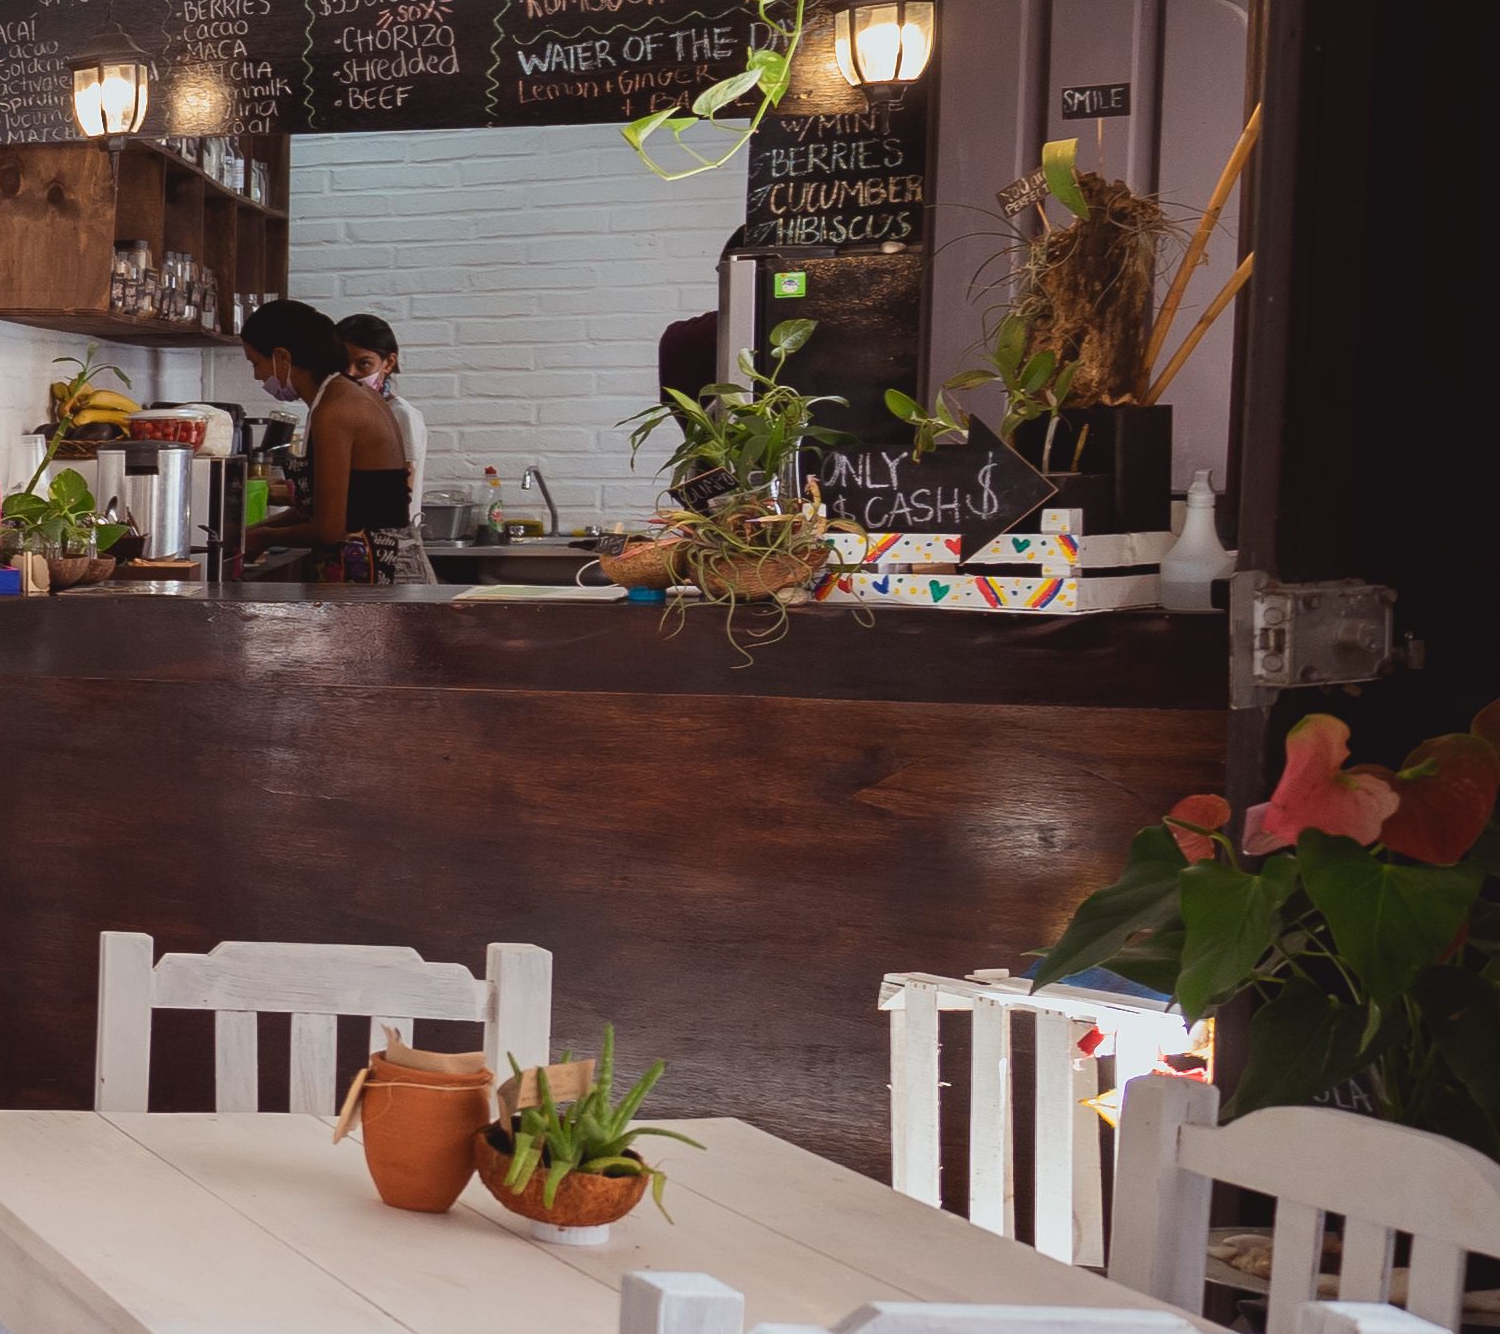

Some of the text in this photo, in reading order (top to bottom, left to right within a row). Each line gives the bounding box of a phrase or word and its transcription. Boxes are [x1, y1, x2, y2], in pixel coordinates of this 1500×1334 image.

[343, 24, 455, 53] CHORIZO
[518, 39, 616, 75] WATER
[622, 32, 664, 61] OF
[670, 27, 738, 62] THE
[349, 84, 414, 110] BEEF
[1063, 88, 1125, 114] SMILE
[7, 127, 78, 145] MATCH
[771, 138, 903, 178] BERRIES
[769, 174, 924, 215] CUCUMBER
[776, 211, 912, 245] HIBISCUS
[820, 450, 908, 491] ONLY
[865, 487, 960, 529] CASH
